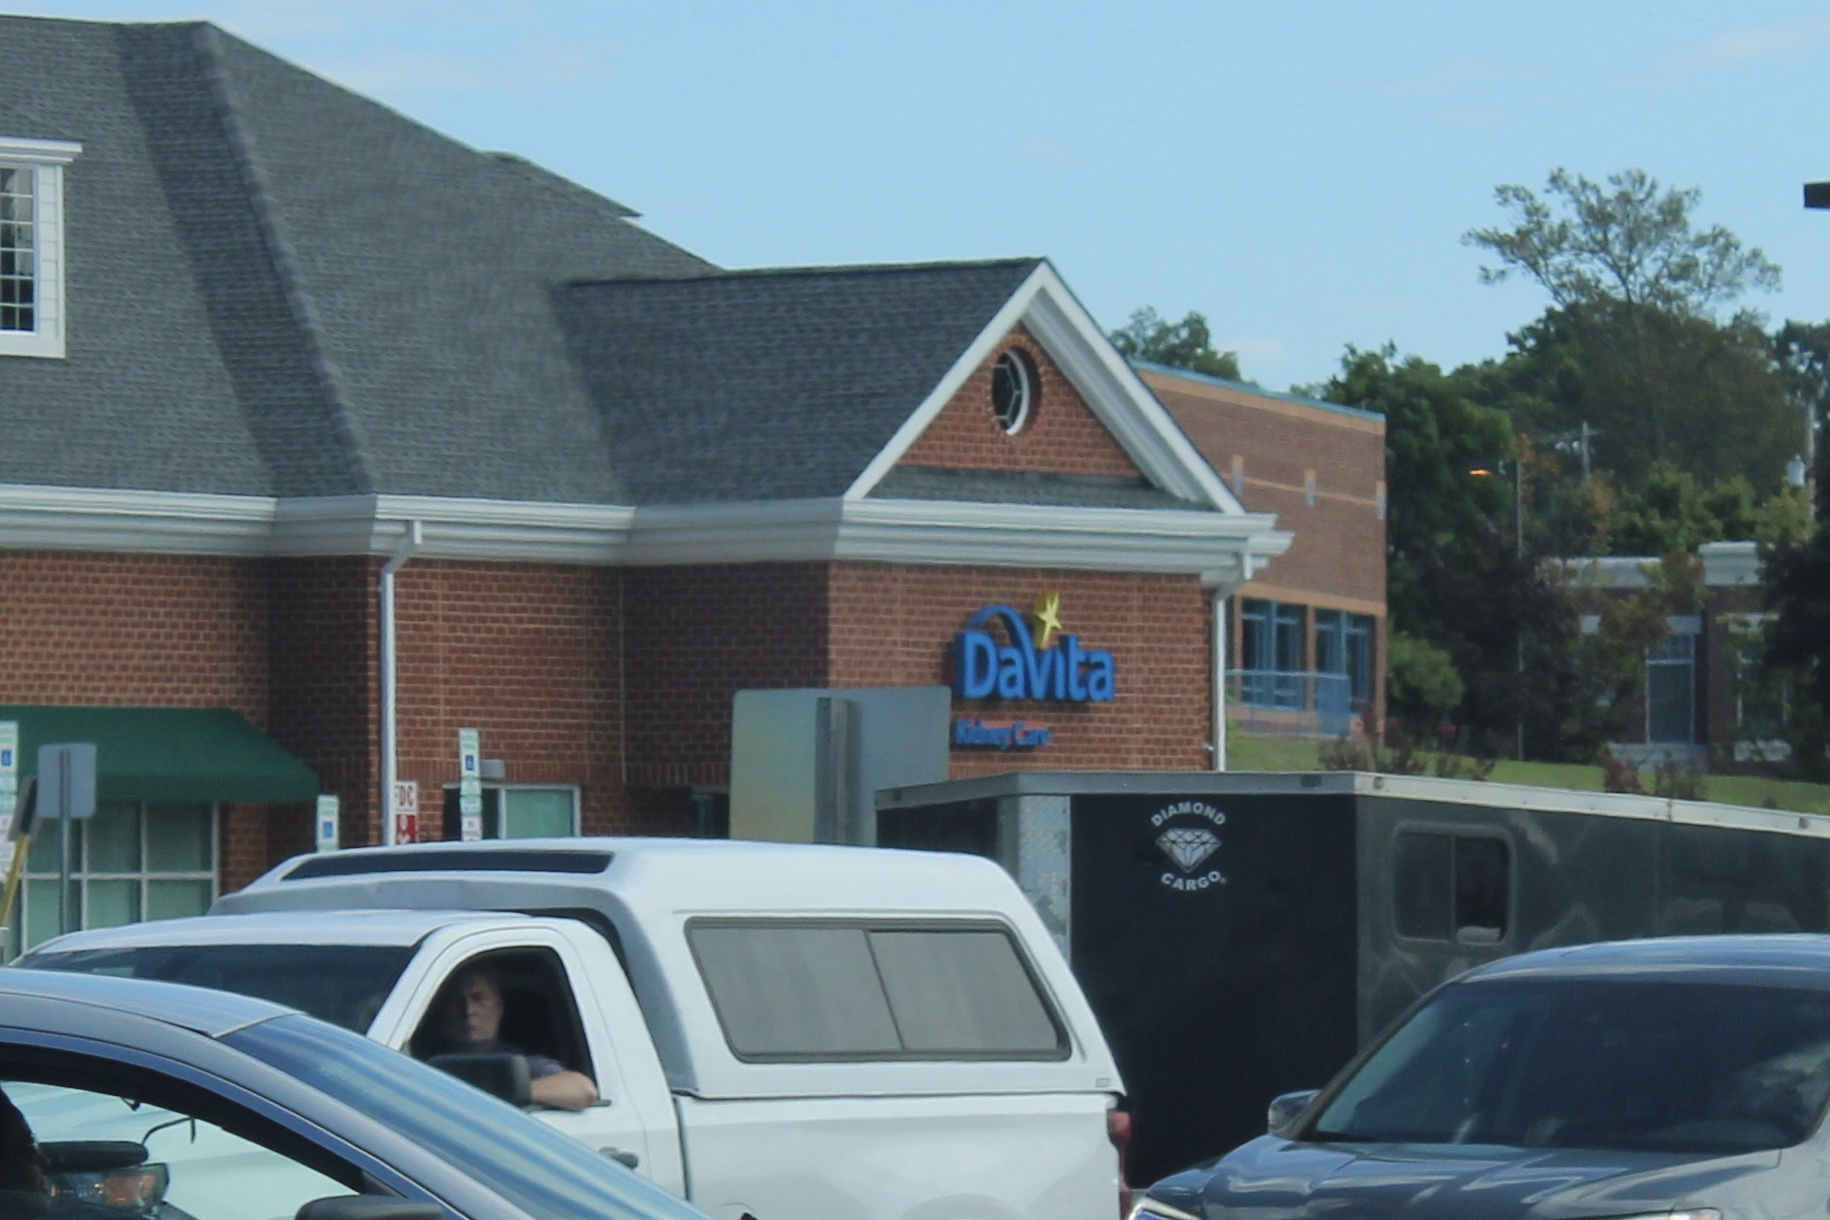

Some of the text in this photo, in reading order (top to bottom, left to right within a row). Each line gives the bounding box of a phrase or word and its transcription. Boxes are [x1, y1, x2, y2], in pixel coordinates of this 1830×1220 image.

[956, 604, 1116, 702] DaVita
[1151, 801, 1226, 826] DIAMOND
[1161, 871, 1221, 890] CARGO
